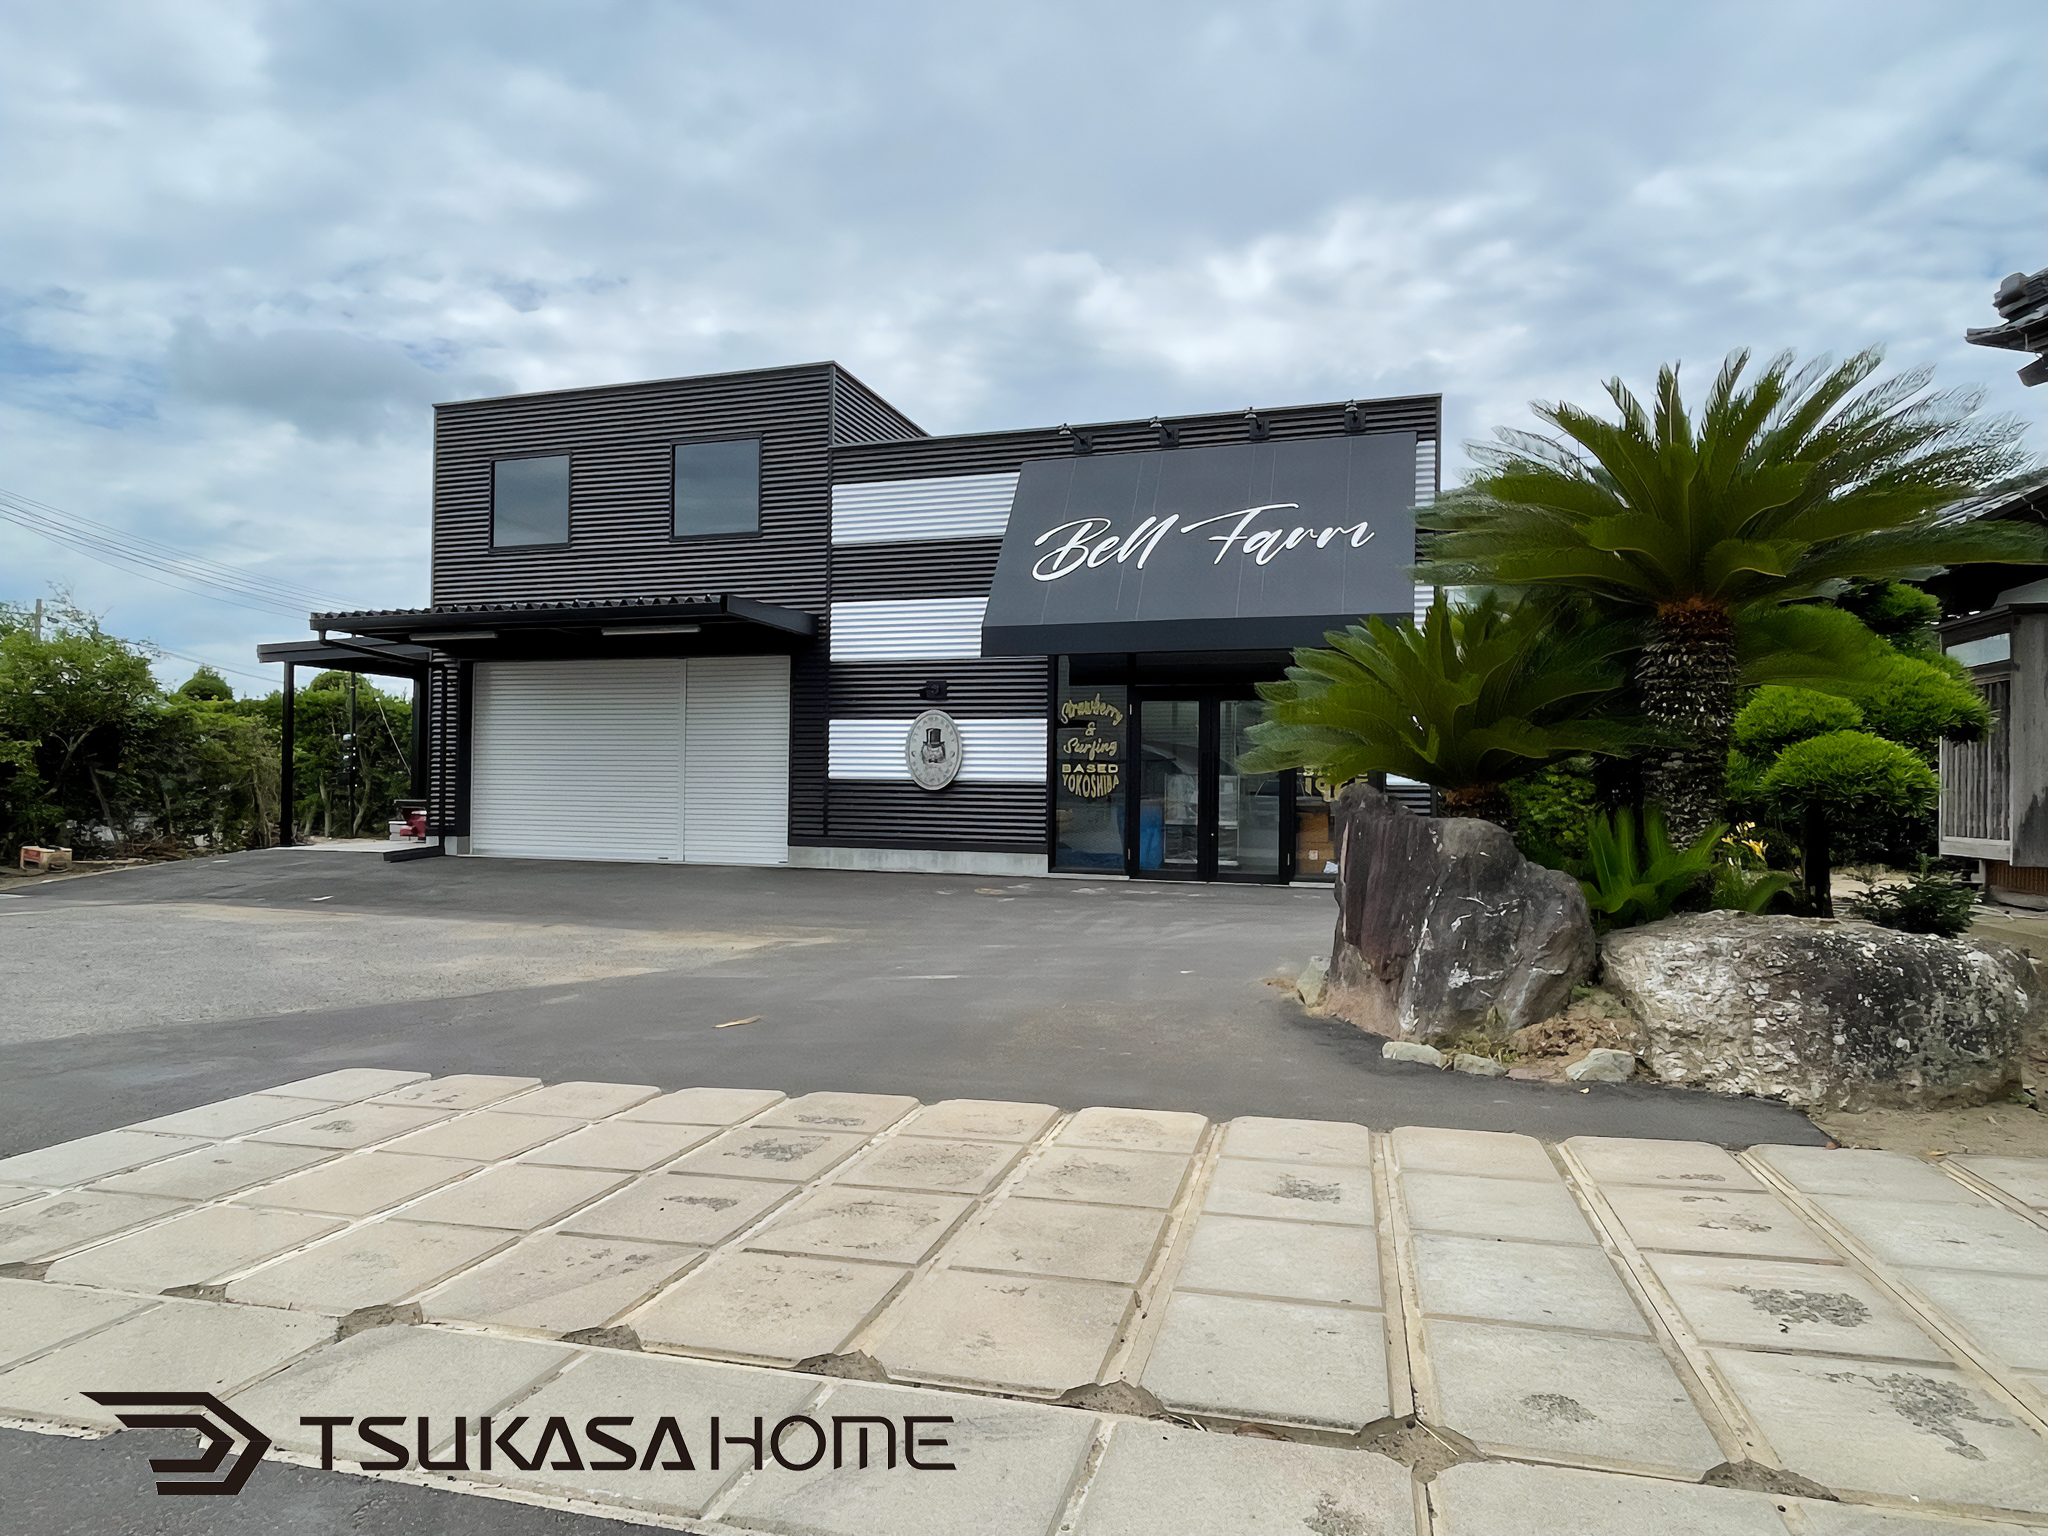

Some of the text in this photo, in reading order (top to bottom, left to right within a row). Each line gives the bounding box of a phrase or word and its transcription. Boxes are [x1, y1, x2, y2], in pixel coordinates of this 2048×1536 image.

[1031, 502, 1376, 583] Bell Farm
[1061, 692, 1124, 726] Strawberry
[1085, 721, 1097, 736] &
[1063, 737, 1118, 761] Surfing
[1061, 763, 1119, 774] BASED
[1062, 774, 1120, 798] YOKOSHIBA
